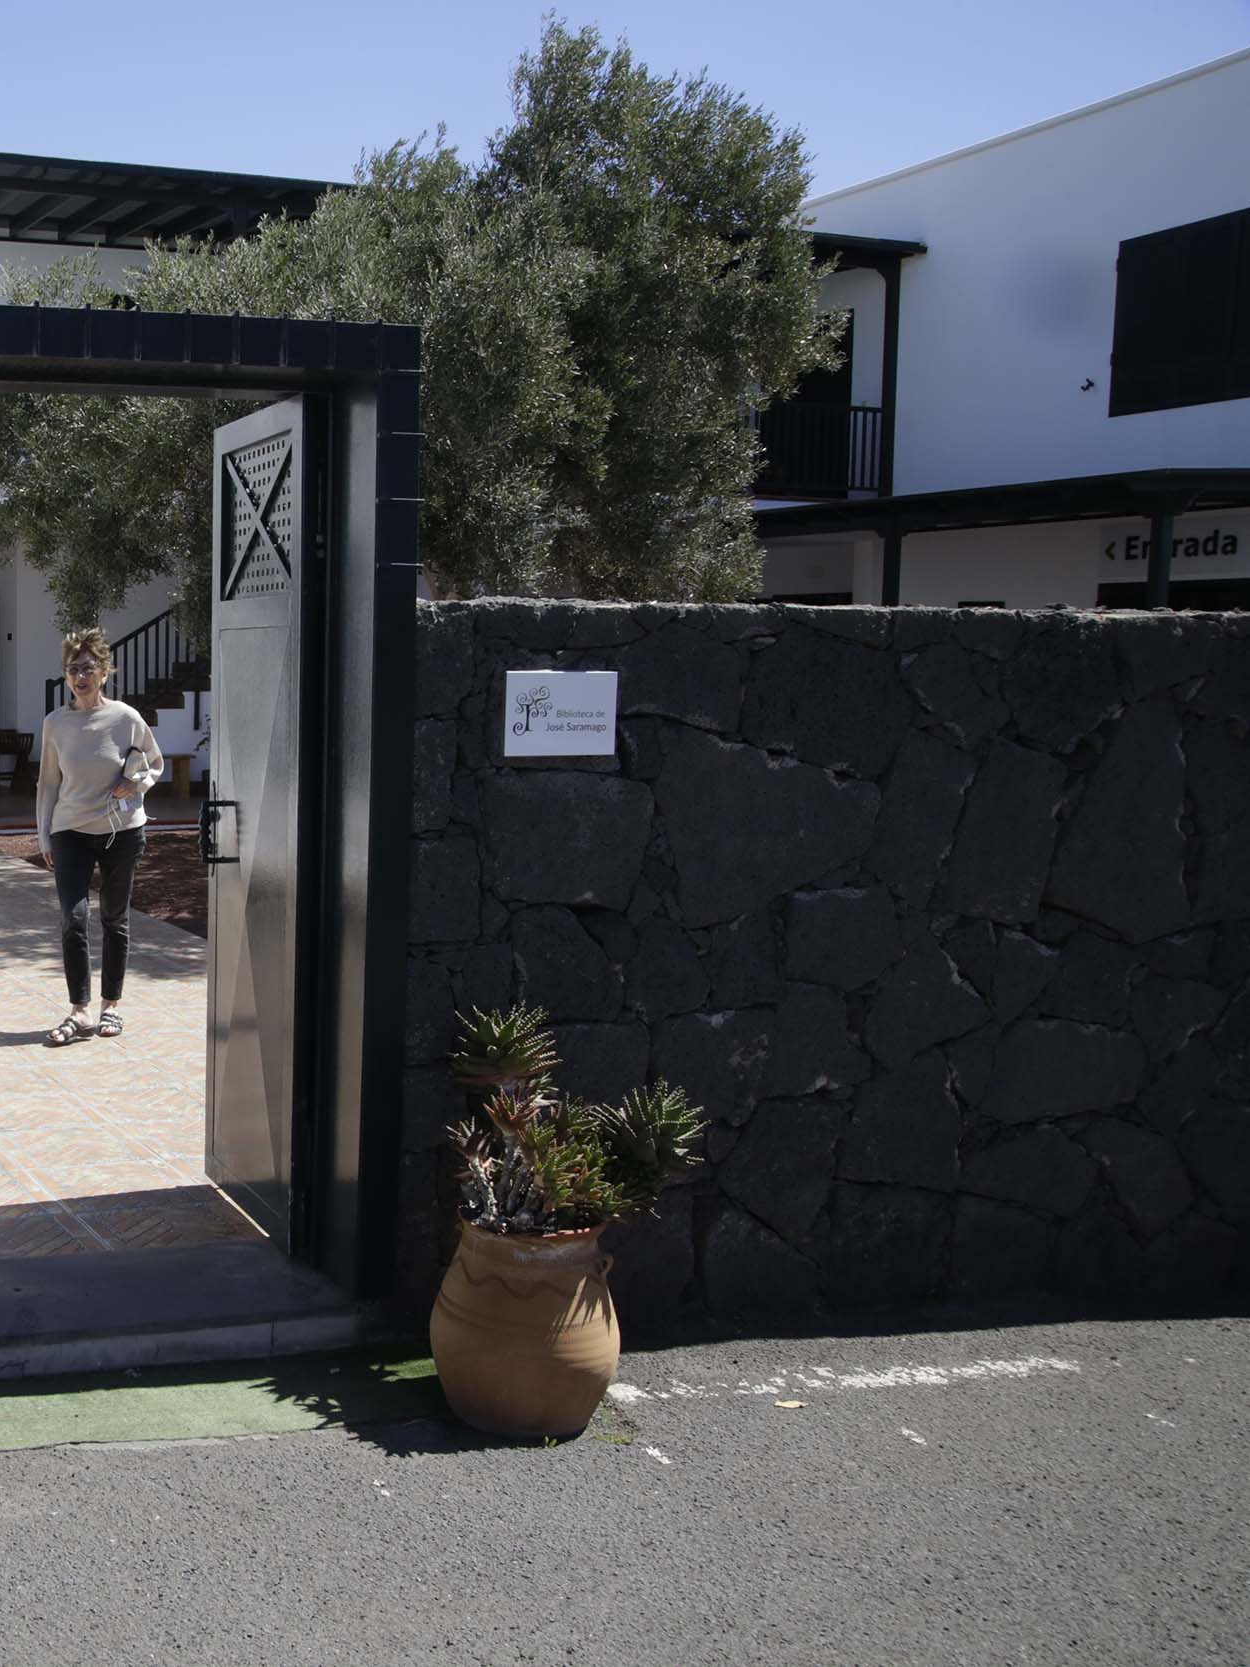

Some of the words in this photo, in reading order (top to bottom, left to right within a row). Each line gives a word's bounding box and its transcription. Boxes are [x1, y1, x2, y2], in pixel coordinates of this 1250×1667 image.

[1124, 529, 1238, 560] Enrada
[555, 709, 594, 719] Biblioteca
[595, 709, 606, 718] de
[545, 721, 565, 732] José
[566, 722, 607, 733] Saramago
